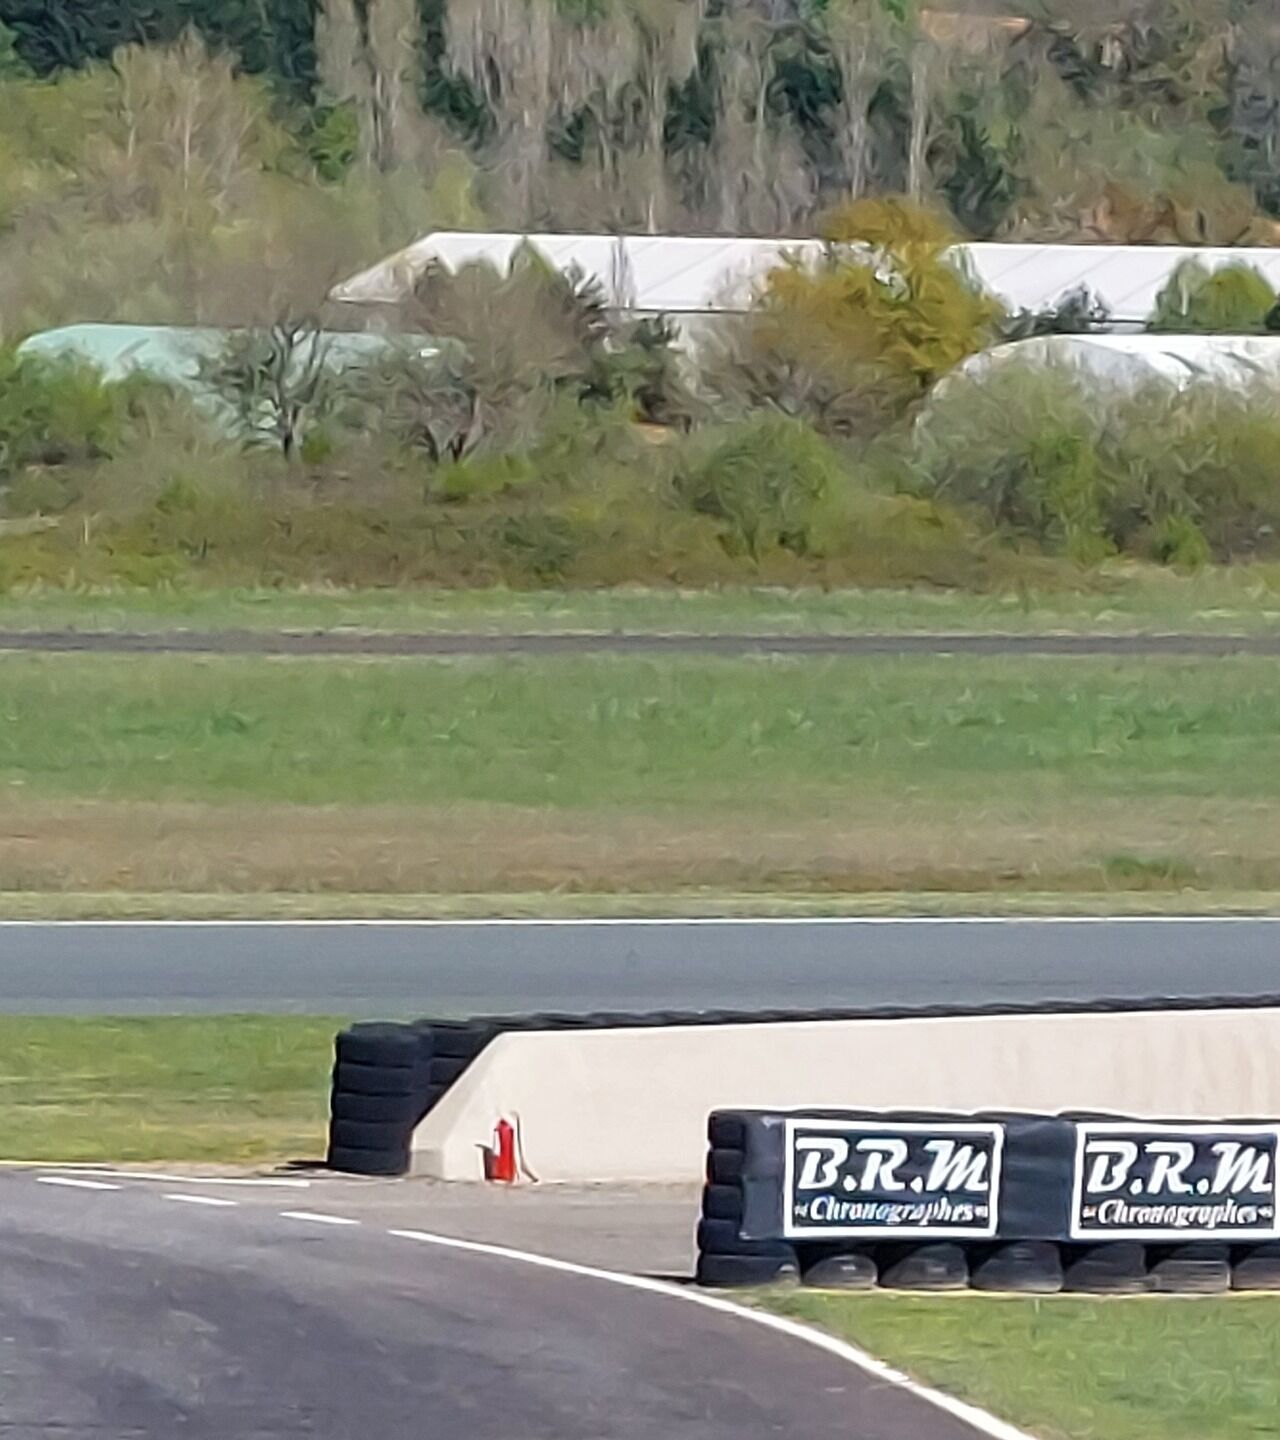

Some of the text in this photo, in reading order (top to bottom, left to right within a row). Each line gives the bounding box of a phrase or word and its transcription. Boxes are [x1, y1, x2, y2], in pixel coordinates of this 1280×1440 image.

[796, 1137, 988, 1193] B.R.M
[1084, 1140, 1273, 1196] B.R.M
[809, 1195, 974, 1226] Chronographes
[1097, 1199, 1258, 1230] Chronographes
